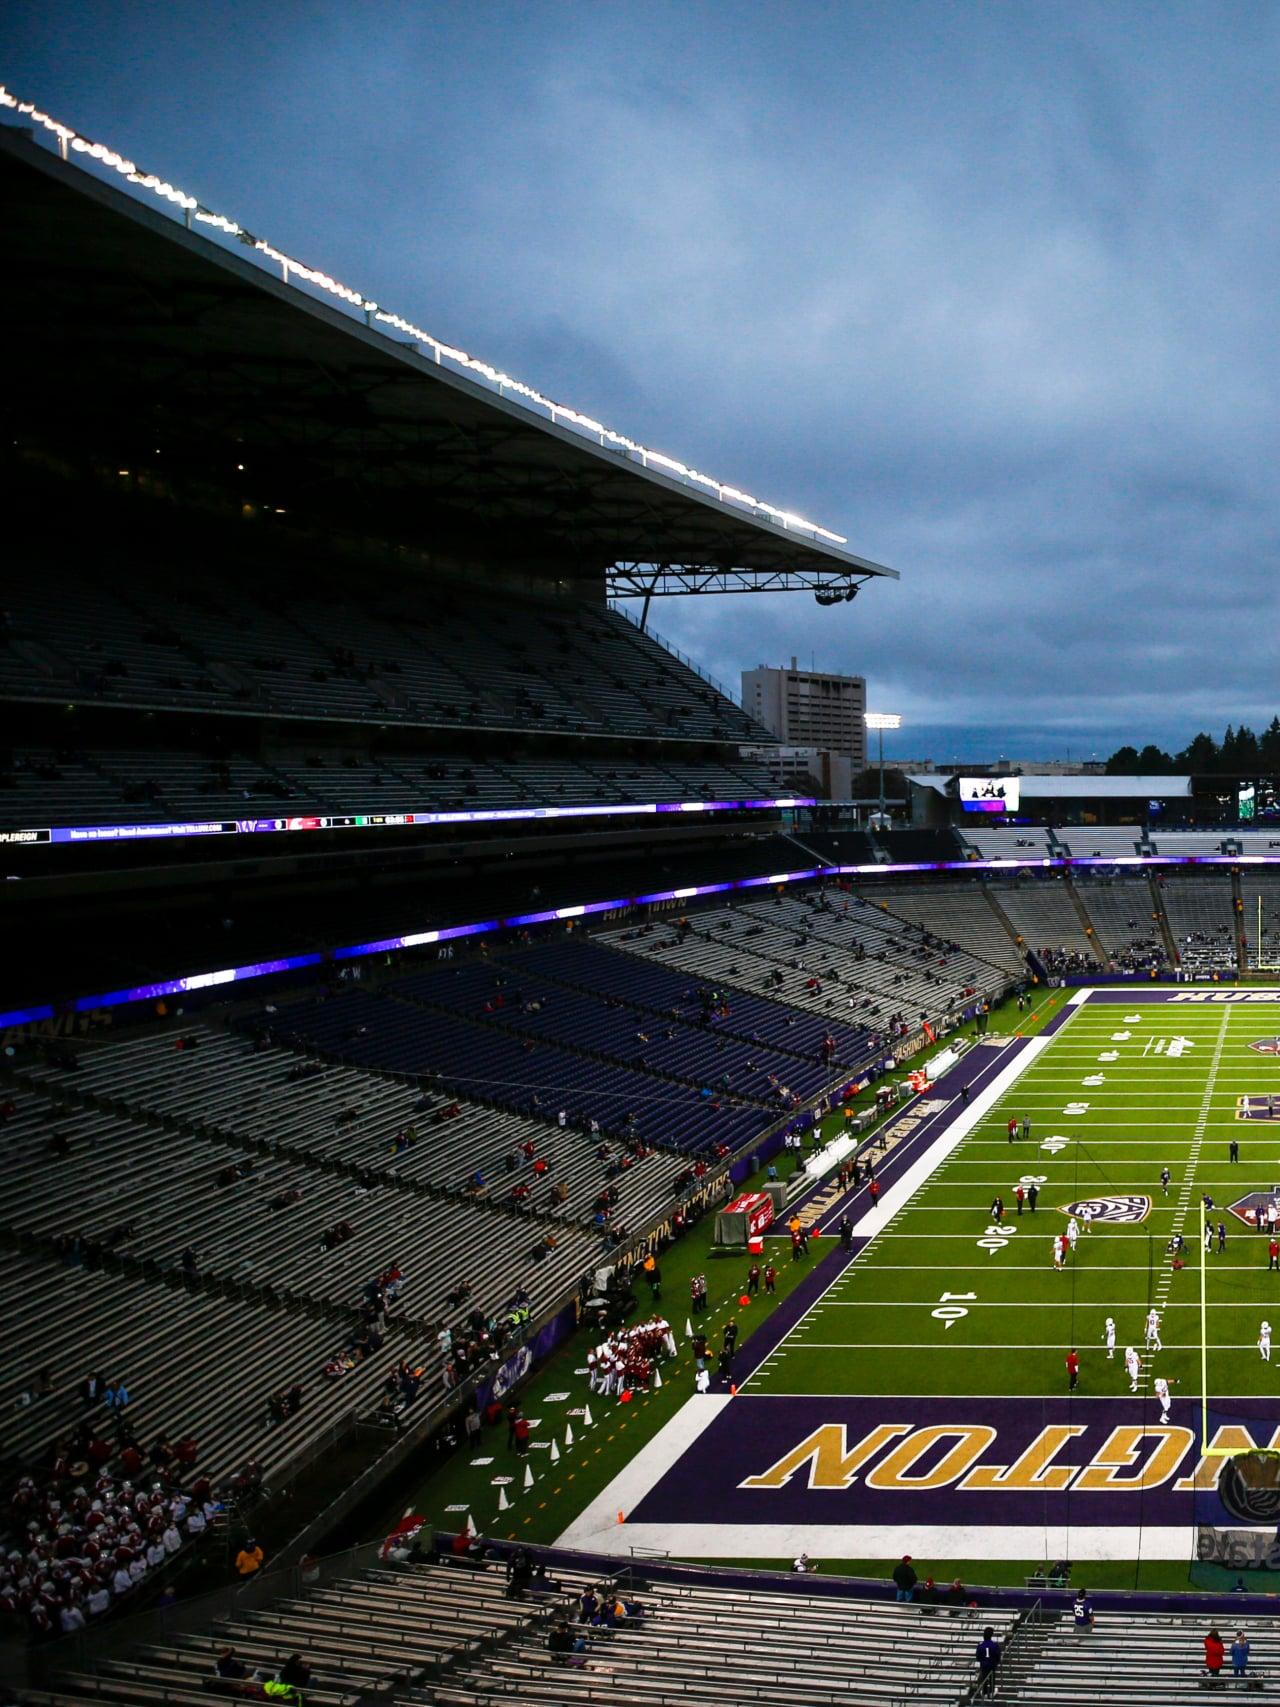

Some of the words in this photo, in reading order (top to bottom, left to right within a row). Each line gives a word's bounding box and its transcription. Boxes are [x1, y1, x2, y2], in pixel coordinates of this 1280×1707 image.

[977, 1225, 1017, 1248] 20
[931, 1292, 977, 1319] 10
[1074, 1604, 1085, 1617] 25
